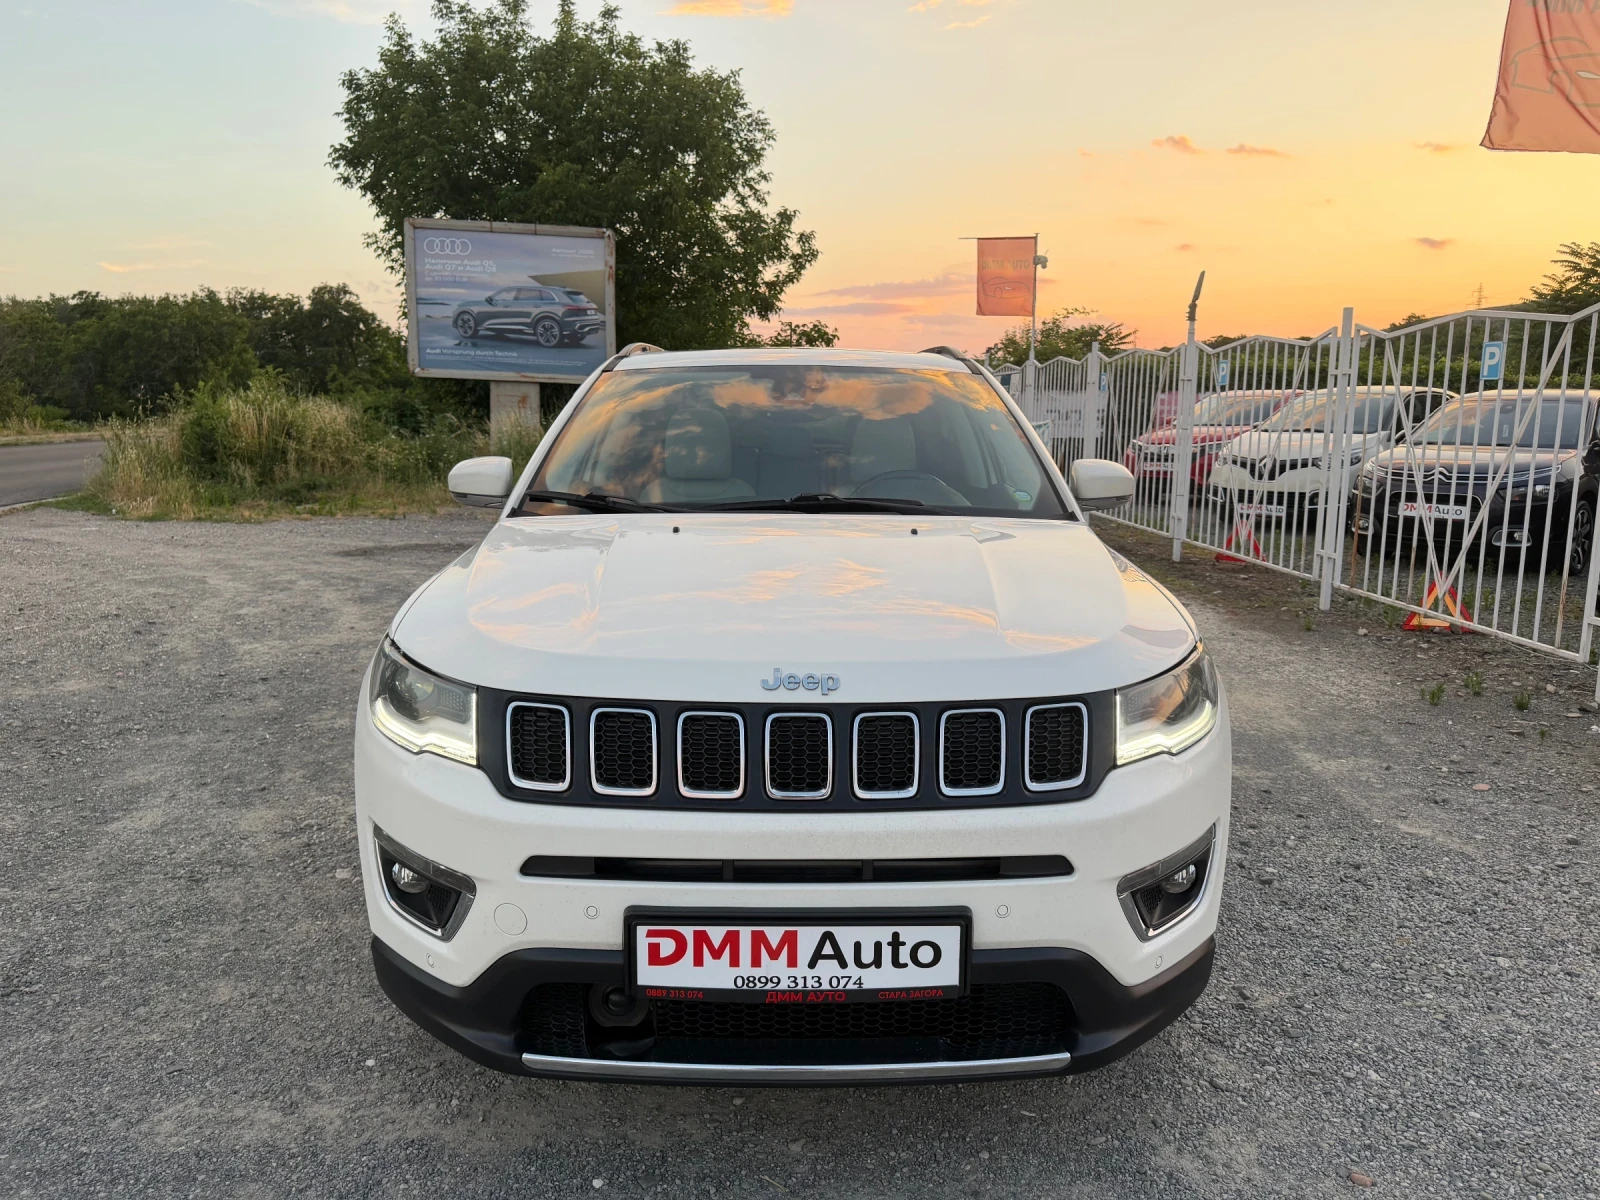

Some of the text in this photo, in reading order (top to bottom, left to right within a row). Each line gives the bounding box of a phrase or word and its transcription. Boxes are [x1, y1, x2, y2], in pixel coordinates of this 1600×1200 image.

[442, 348, 475, 356] Vorsprung
[1483, 346, 1500, 376] P
[1218, 363, 1227, 382] P
[760, 667, 840, 696] Jeep
[645, 928, 942, 970] DMM Auto
[734, 975, 864, 989] 0899 313 074
[646, 988, 703, 999] 0889 313 074
[765, 991, 846, 1004] ДММ АУТО
[878, 988, 943, 1000] СТАРА ЗАГОРА
